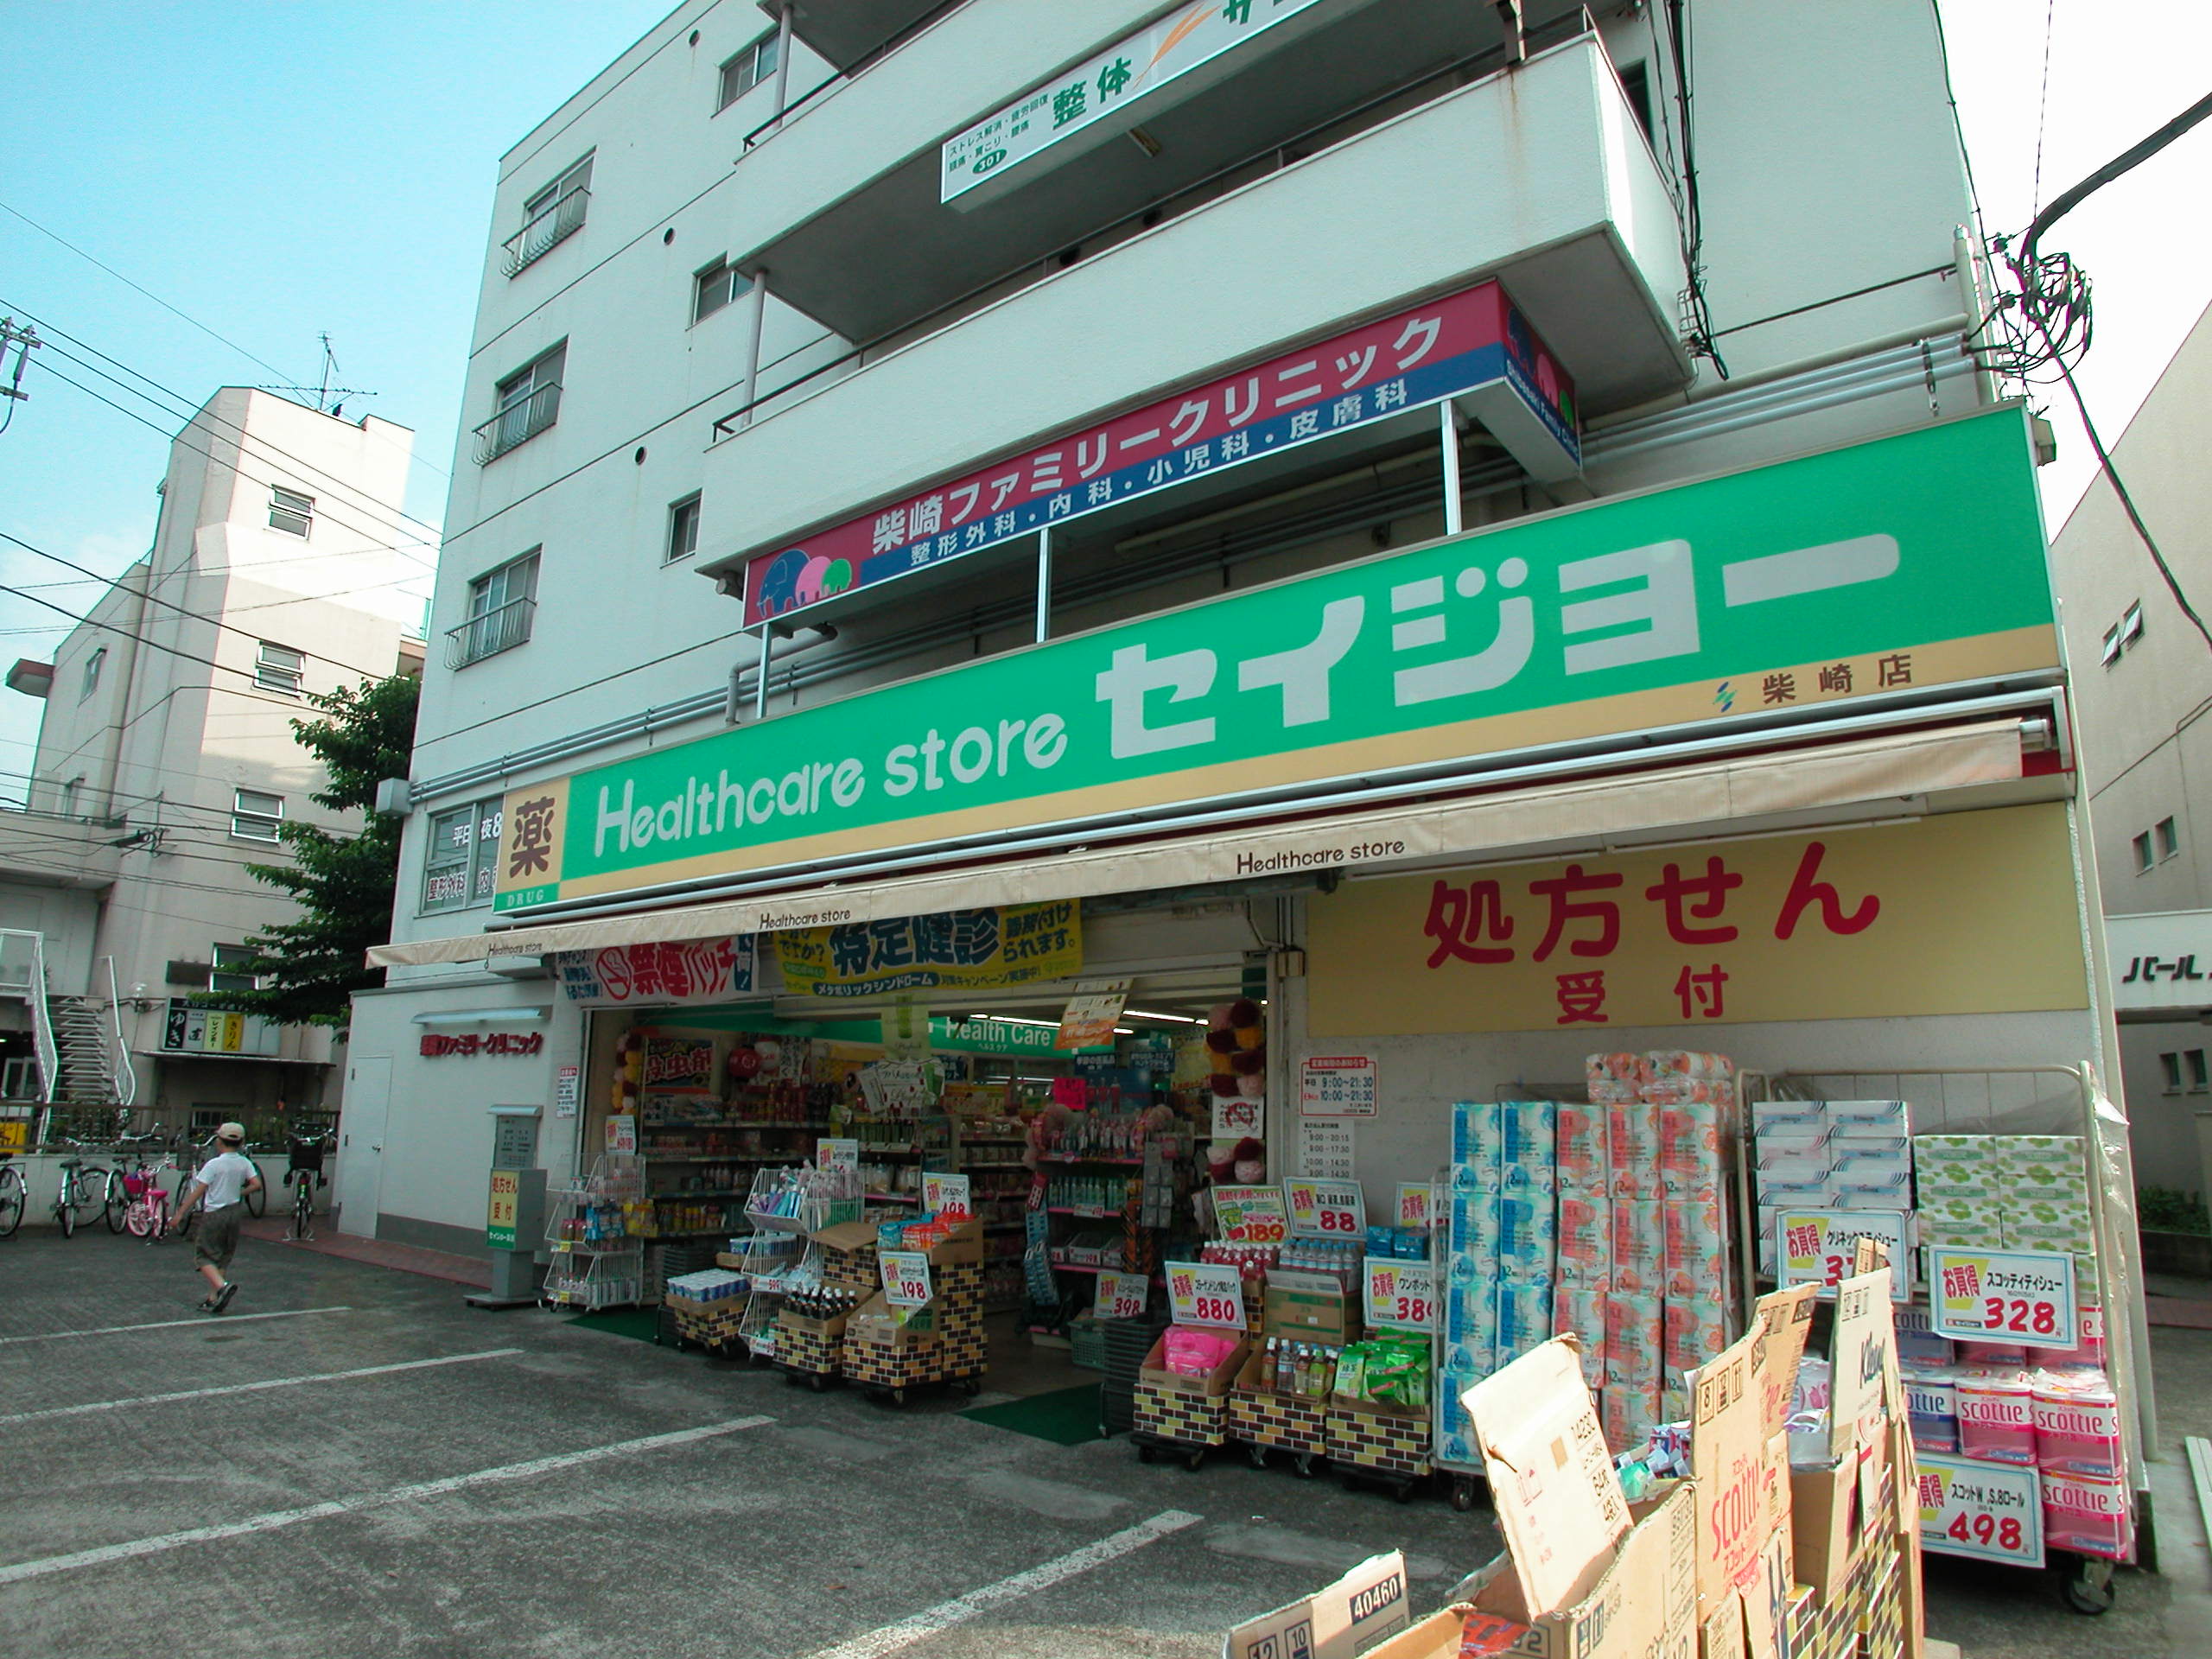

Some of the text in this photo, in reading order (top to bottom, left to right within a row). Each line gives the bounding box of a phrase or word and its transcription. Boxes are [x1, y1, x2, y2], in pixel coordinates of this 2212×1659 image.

[1052, 57, 1131, 130] 整体
[978, 150, 1002, 173] 301
[874, 316, 1444, 555] 柴崎ファミリークリニック
[1096, 532, 1900, 760] セイジョー
[1762, 653, 1914, 706] 柴崎店
[594, 711, 1069, 858] Healthcare store
[509, 795, 556, 879] 薬
[1237, 840, 1406, 874] Healthcare store
[507, 888, 545, 907] DRUG
[1423, 841, 1881, 970] 処方せん
[760, 909, 851, 929] Healthcare store
[2121, 953, 2212, 984] パール
[1555, 963, 1729, 1025] 受付
[1010, 1025, 1052, 1047] Care
[1319, 1210, 1356, 1232] 88
[1402, 1194, 1424, 1220] お買得
[1244, 1223, 1285, 1243] 189
[1786, 1224, 1821, 1258] お買得
[901, 1281, 926, 1300] 198
[1372, 1272, 1395, 1297] お買得
[1942, 1264, 1980, 1299] お買得
[1986, 1272, 2063, 1292] スコッティティシュー
[1197, 1297, 1235, 1321] 880
[1893, 1311, 1929, 1331] cotti
[1984, 1297, 2056, 1334] 328
[1906, 1392, 1945, 1414] ottie
[1961, 1401, 2023, 1423] scottie
[2037, 1409, 2103, 1434] scottie
[1918, 1474, 1945, 1508] 買得
[2042, 1483, 2108, 1512] scottie
[1948, 1511, 2022, 1550] 498
[1353, 1576, 1399, 1619] 40460
[1293, 1626, 1306, 1646] 10
